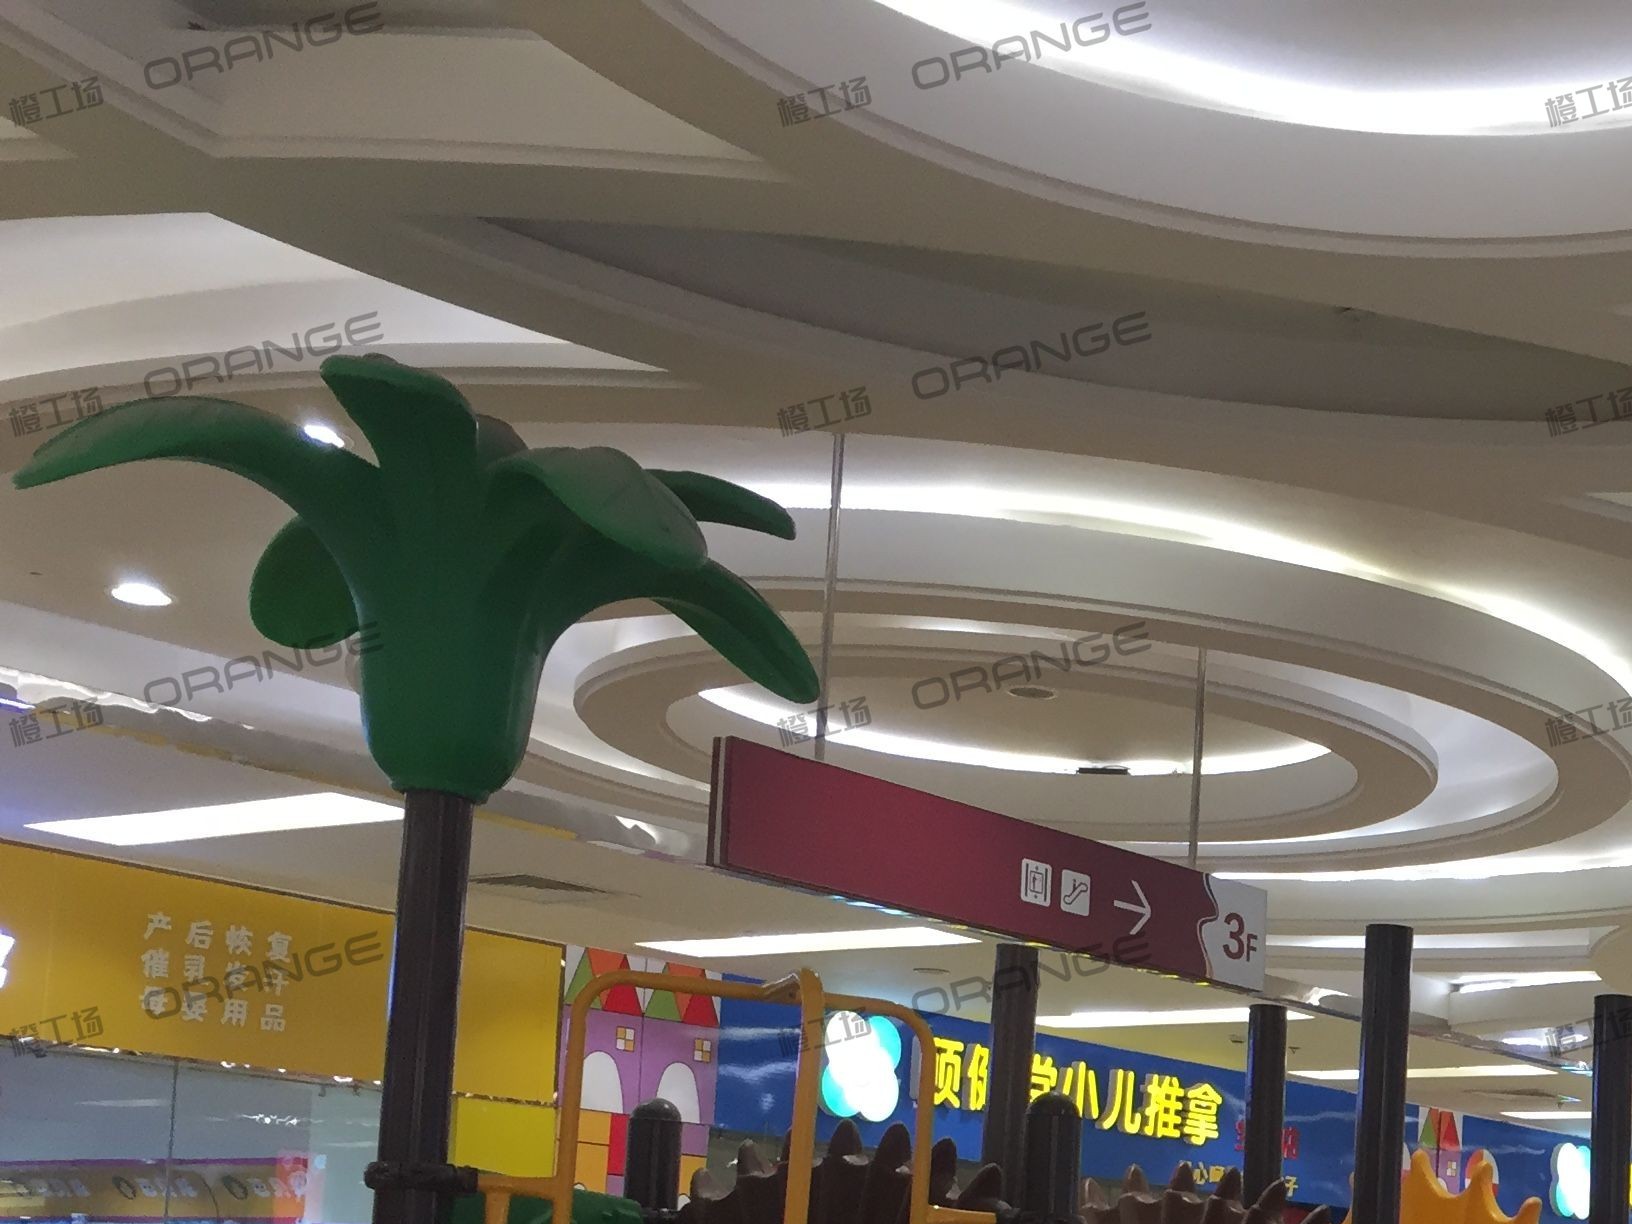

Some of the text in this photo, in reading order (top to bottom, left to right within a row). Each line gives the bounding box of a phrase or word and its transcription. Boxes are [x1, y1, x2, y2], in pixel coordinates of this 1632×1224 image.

[143, 911, 292, 963] 产后恢复
[1222, 912, 1258, 962] 3F
[139, 985, 286, 1032] 母婴用品
